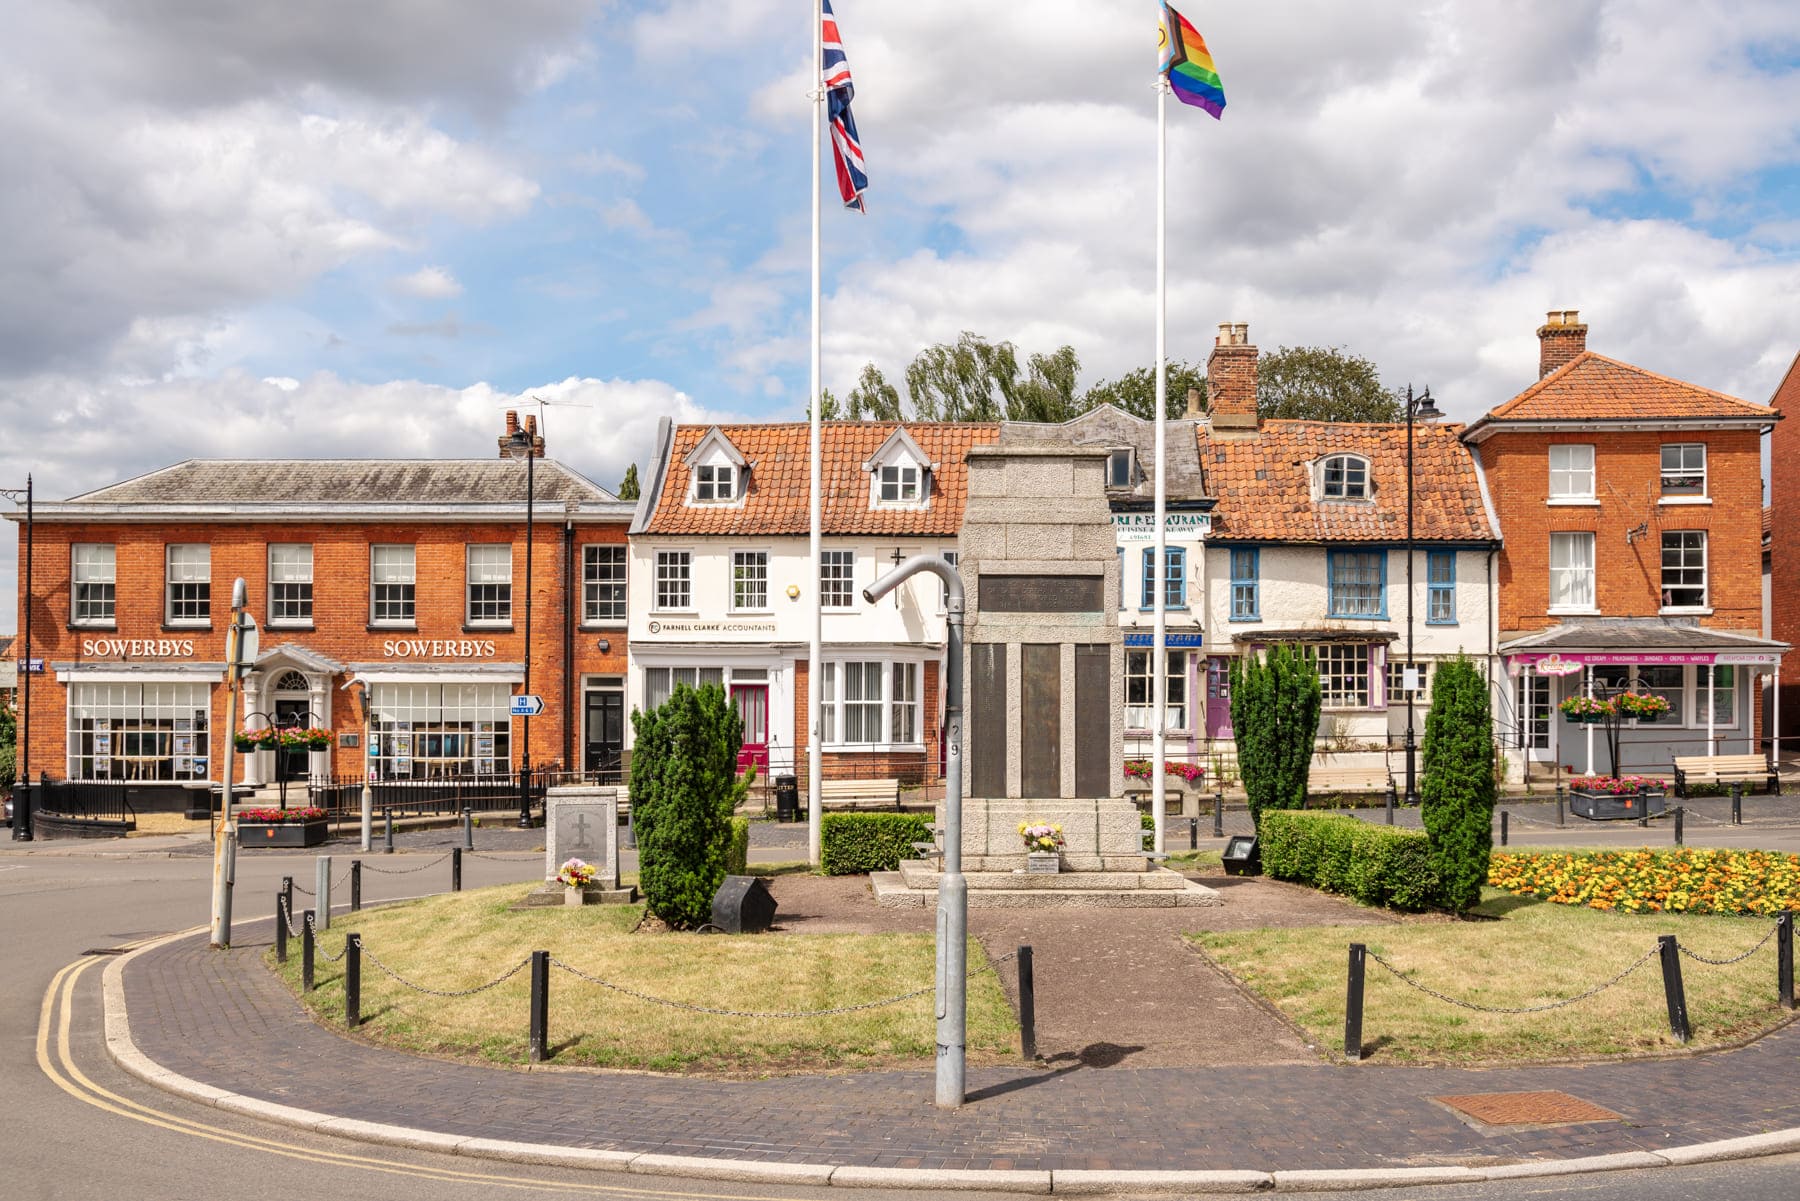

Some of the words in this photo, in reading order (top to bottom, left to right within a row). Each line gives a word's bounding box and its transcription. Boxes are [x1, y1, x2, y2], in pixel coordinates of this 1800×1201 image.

[1135, 515, 1210, 525] RESAURANT
[722, 624, 776, 632] ACCOUNTANTS
[83, 639, 195, 657] SOWERBYS
[383, 639, 496, 657] SOWERBYS
[951, 744, 958, 756] 9
